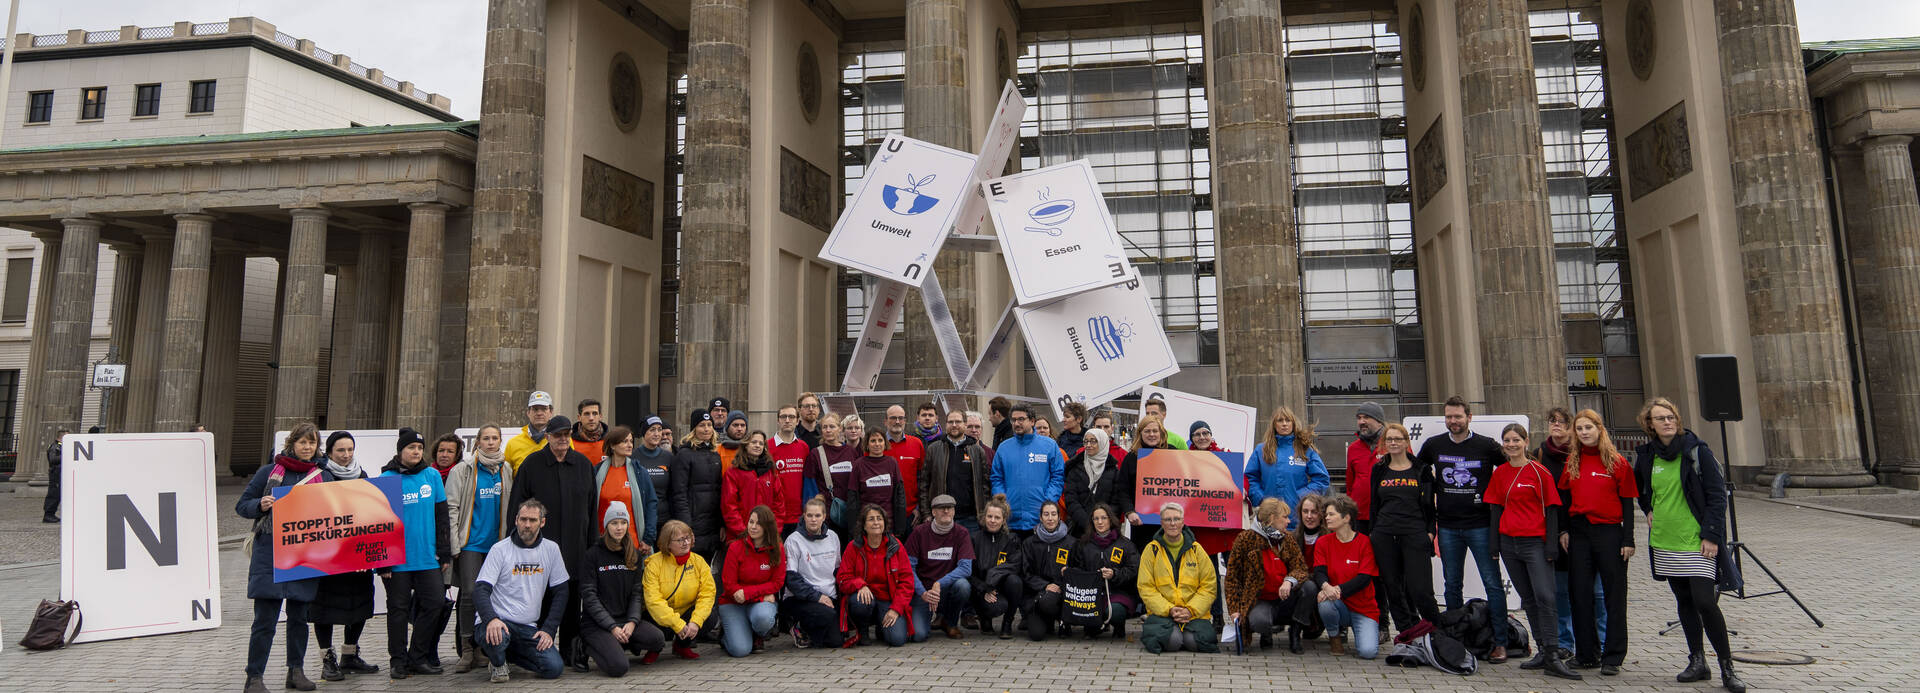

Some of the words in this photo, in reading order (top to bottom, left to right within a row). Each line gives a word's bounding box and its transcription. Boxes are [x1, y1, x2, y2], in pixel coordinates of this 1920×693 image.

[887, 139, 904, 152] U
[990, 182, 1005, 196] E
[872, 220, 912, 238] Umwelt
[1045, 244, 1082, 258] Essen
[903, 264, 921, 280] U
[1108, 262, 1126, 278] E
[1066, 326, 1088, 372] Bildung
[1410, 423, 1423, 440] #
[73, 440, 94, 461] N
[1143, 477, 1180, 486] STOPPT
[1184, 479, 1200, 487] DIE
[1380, 478, 1418, 486] OXFAM
[1142, 486, 1234, 499] HILFSKÜRZUNGEN!
[106, 492, 178, 570] N
[282, 517, 330, 532] STOPPT
[334, 515, 353, 526] DIE
[282, 522, 394, 545] HILFSKÜRZUNGEN!
[366, 548, 386, 556] NACH
[366, 554, 388, 562] OBEN
[1066, 584, 1098, 596] Refugees
[1066, 592, 1096, 602] welcome
[192, 599, 211, 620] N
